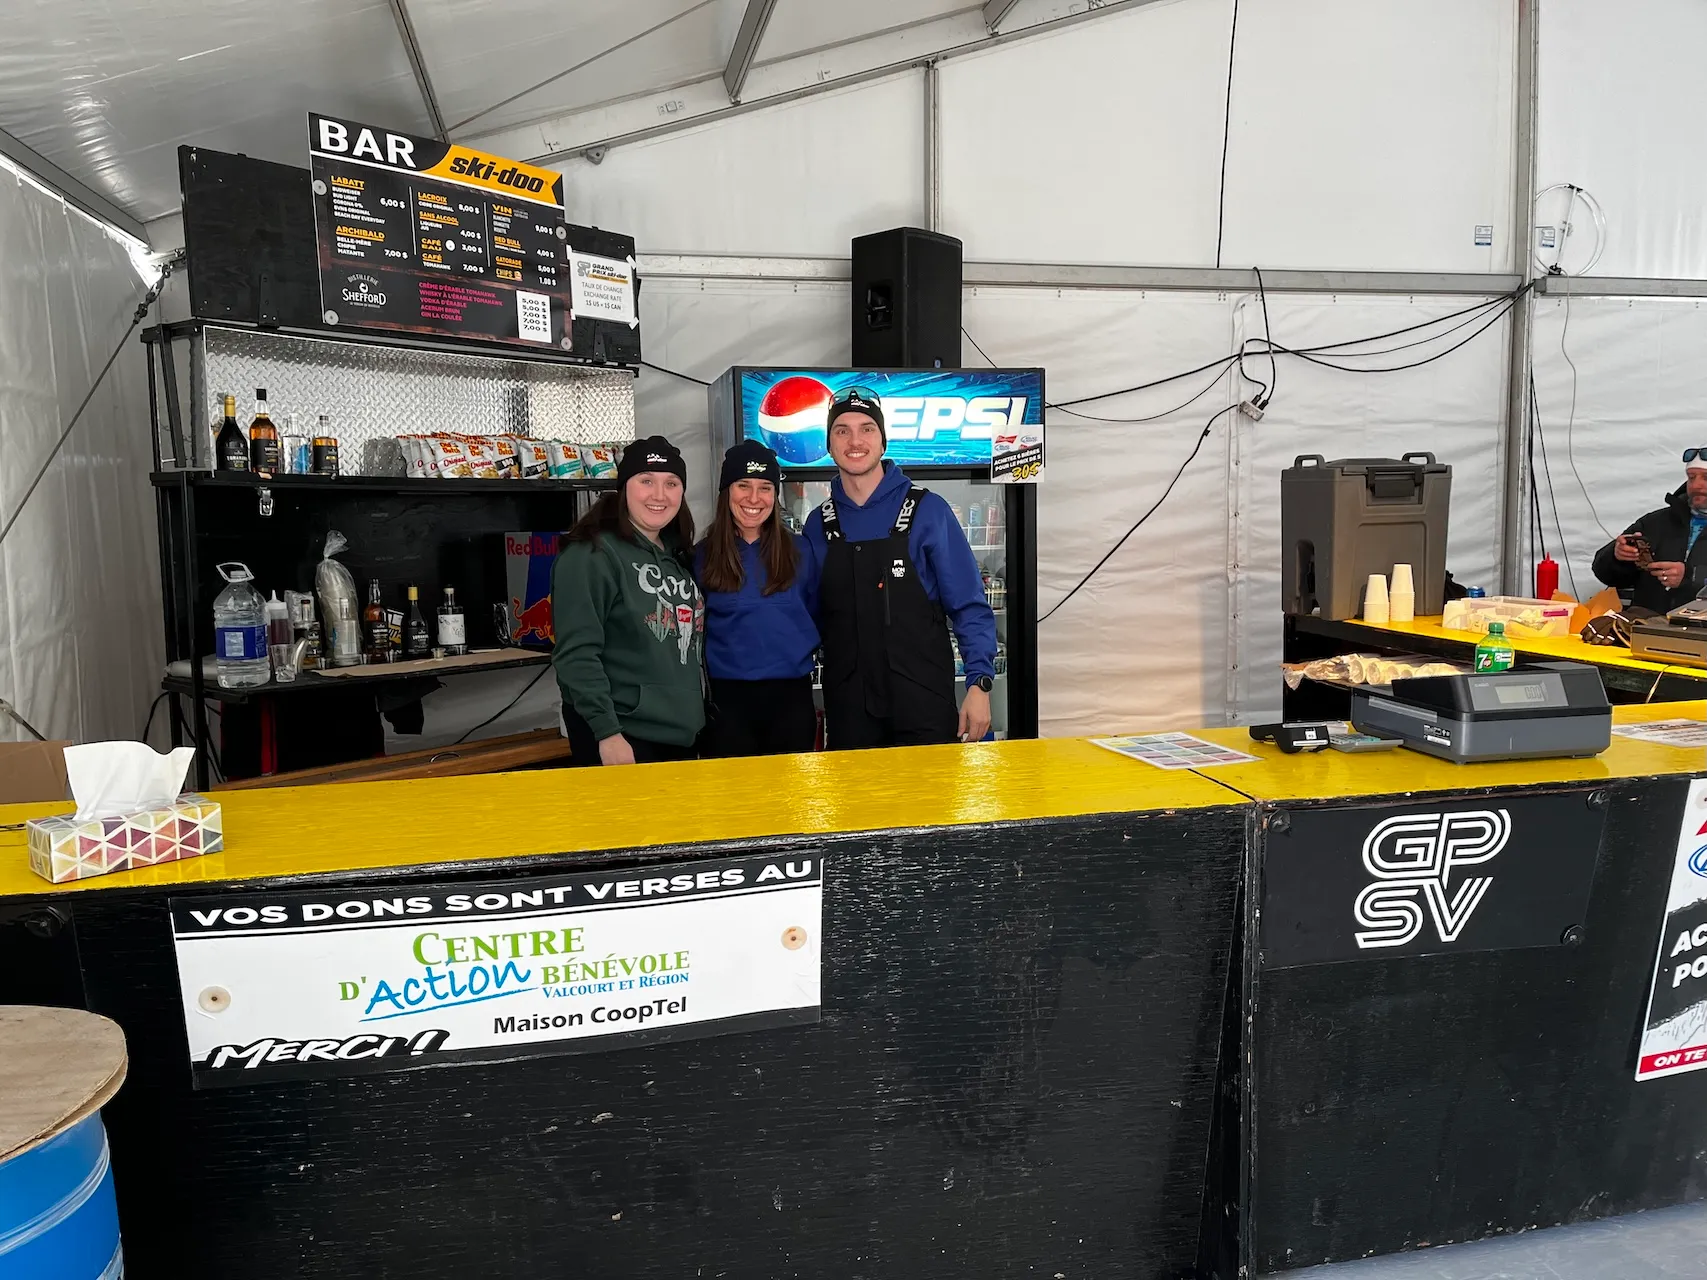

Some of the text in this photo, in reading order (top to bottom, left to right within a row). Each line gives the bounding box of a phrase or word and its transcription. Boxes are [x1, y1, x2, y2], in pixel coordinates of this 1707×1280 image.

[318, 118, 416, 169] BAR
[450, 157, 545, 194] ski-doo
[330, 175, 364, 188] LABATT
[332, 186, 361, 196] BUDWEISER
[332, 192, 358, 202] BUD LIGHT
[418, 192, 448, 203] LACROIX
[333, 199, 355, 208] CORONA
[380, 198, 406, 209] 6,00 $
[433, 204, 454, 212] ORIGINAL
[458, 203, 474, 213] 8,00
[492, 204, 512, 214] VIN
[348, 207, 370, 216] ORIGINAL
[361, 216, 386, 224] EVERYDAY
[419, 211, 459, 224] SANS ALCOOL
[336, 225, 385, 239] ARCHIBALD
[460, 229, 481, 240] 4,00 $
[535, 224, 553, 235] 9,00 $
[336, 236, 372, 247] BELLE-MÈRE
[421, 238, 442, 246] CAFÉ
[506, 238, 521, 247] BULL
[338, 248, 365, 257] MATANTE
[462, 244, 477, 252] 3,00
[537, 249, 550, 258] 4,00
[384, 249, 408, 259] 7,00 $
[422, 252, 442, 261] CAFÉ
[495, 256, 522, 266] GATORADE
[463, 264, 484, 274] 7,00 $
[496, 268, 513, 278] CHIPS
[538, 265, 551, 273] 5,00
[592, 264, 614, 272] GRAND
[347, 274, 379, 286] DISTILLERIE
[419, 281, 496, 298] CRÈME D'ÉRABLE TOMAHAWK
[603, 285, 623, 294] CHANGE
[342, 288, 386, 306] SHEFFORD
[419, 289, 442, 298] WHISKY
[448, 292, 472, 302] L'ÉRABLE
[473, 297, 503, 306] TOMAHAWK
[583, 291, 622, 302] EXCHANGE RATE
[420, 297, 467, 308] VODKA D'ÉRABLE
[604, 302, 610, 310] 1$
[445, 306, 461, 314] BRUN
[440, 313, 462, 322] COULÉE
[880, 396, 1026, 441] EPSI
[562, 445, 572, 453] Old
[443, 455, 467, 467] Original
[994, 454, 1017, 466] ACHETEZ
[1021, 448, 1040, 458] BIÈRES
[470, 460, 493, 469] Original
[995, 463, 1010, 472] POUR
[1016, 458, 1029, 466] PRIX
[1012, 462, 1041, 482] 30$
[506, 536, 559, 556] Red Bull
[190, 858, 812, 927] VOS DONS SONT VERSES AU
[412, 927, 585, 966] CENTRE
[541, 950, 690, 986] BÉNÉVOLE
[543, 972, 690, 1000] VALCOURT ET RÉGION
[493, 997, 688, 1034] Maison CoopTel
[211, 1031, 439, 1069] MERCI !
[1653, 1048, 1707, 1068] ON TE
